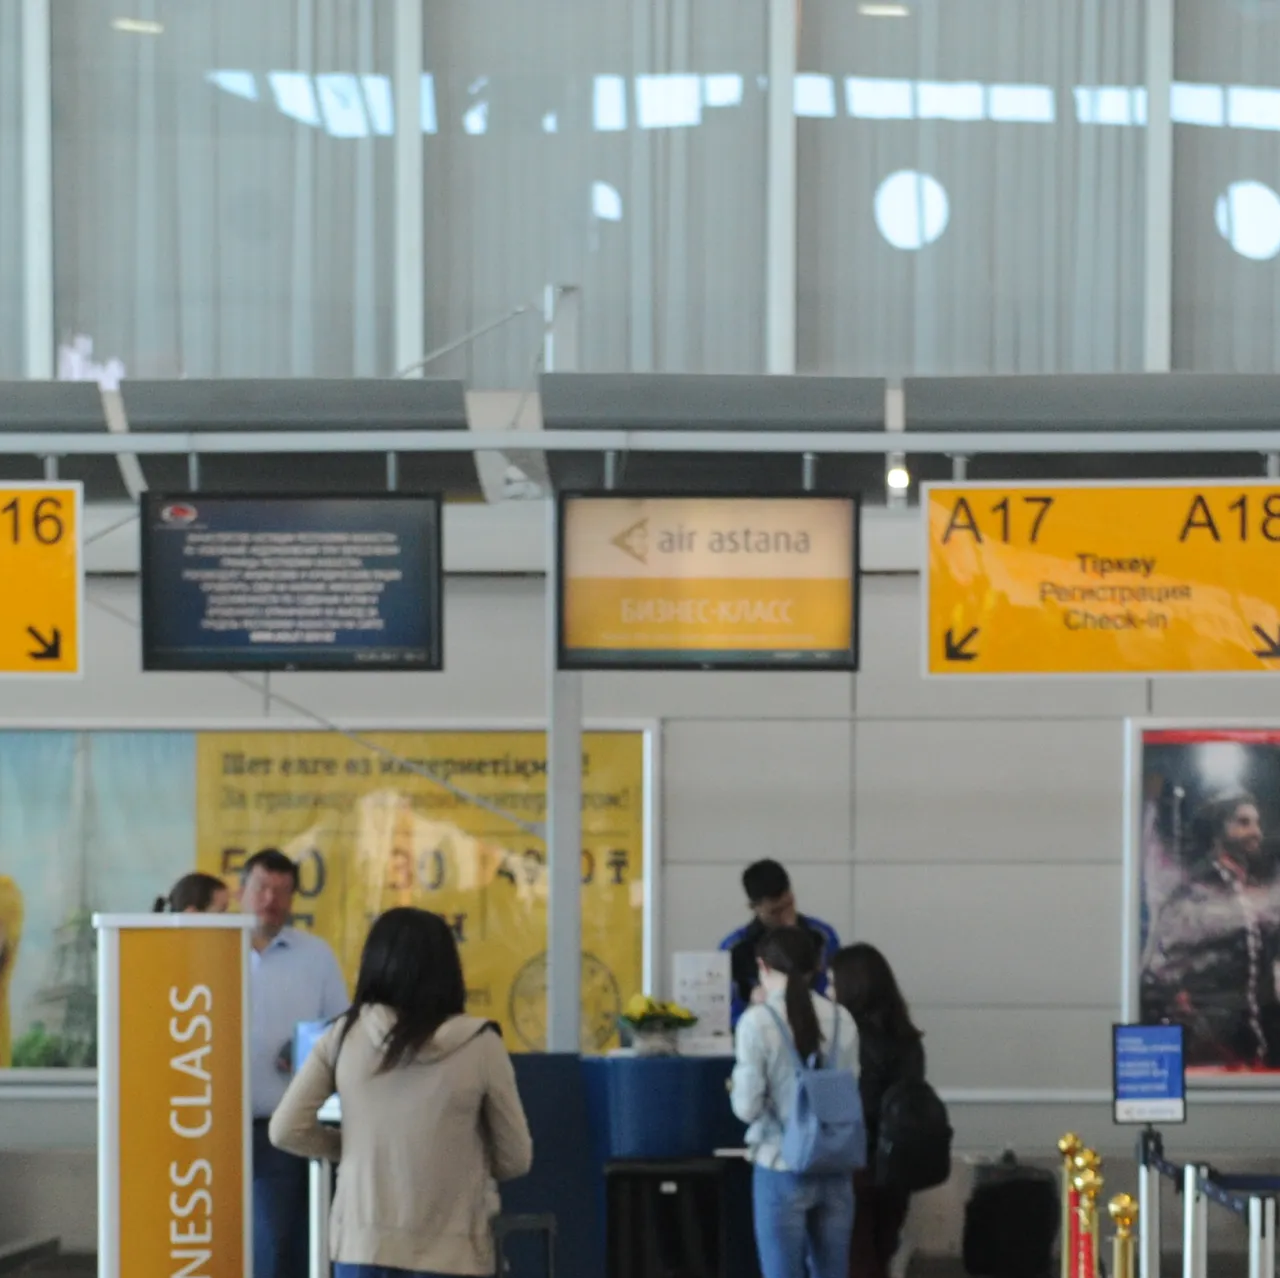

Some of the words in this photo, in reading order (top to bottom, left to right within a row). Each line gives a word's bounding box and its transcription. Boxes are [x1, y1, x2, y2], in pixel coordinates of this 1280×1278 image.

[942, 496, 1054, 544] A17
[657, 525, 697, 554] air
[708, 527, 811, 555] astana
[1039, 581, 1191, 604] Регистрация
[620, 598, 794, 624] БИЗНЕС-КЛАСС
[1064, 608, 1168, 630] Check-in
[169, 983, 213, 1138] CLASS
